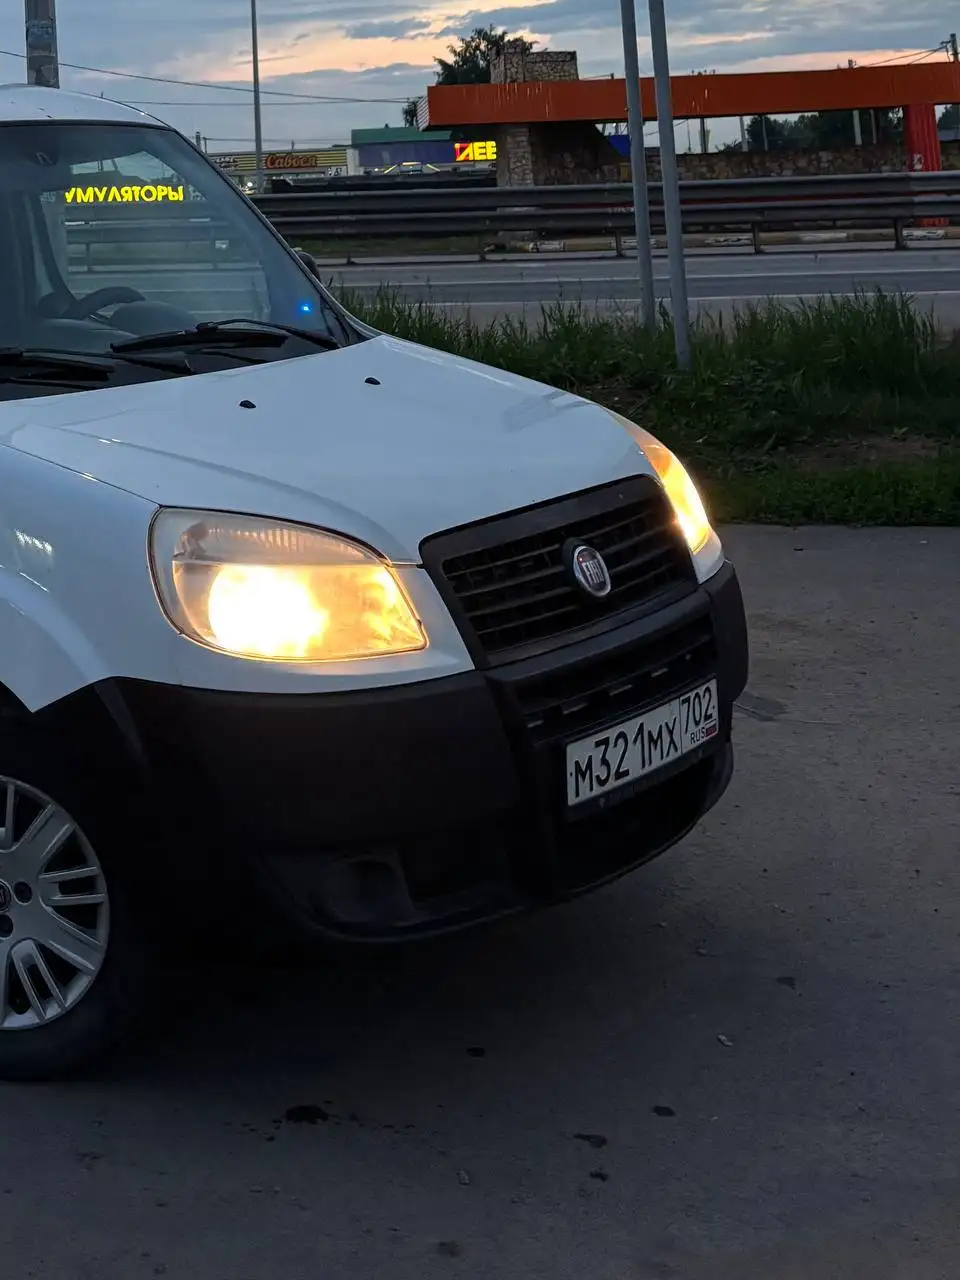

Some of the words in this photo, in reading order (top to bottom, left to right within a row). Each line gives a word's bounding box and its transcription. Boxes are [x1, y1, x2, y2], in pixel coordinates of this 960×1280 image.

[574, 716, 679, 799] М321МХ
[681, 686, 713, 735] 702
[690, 727, 706, 745] RUS
